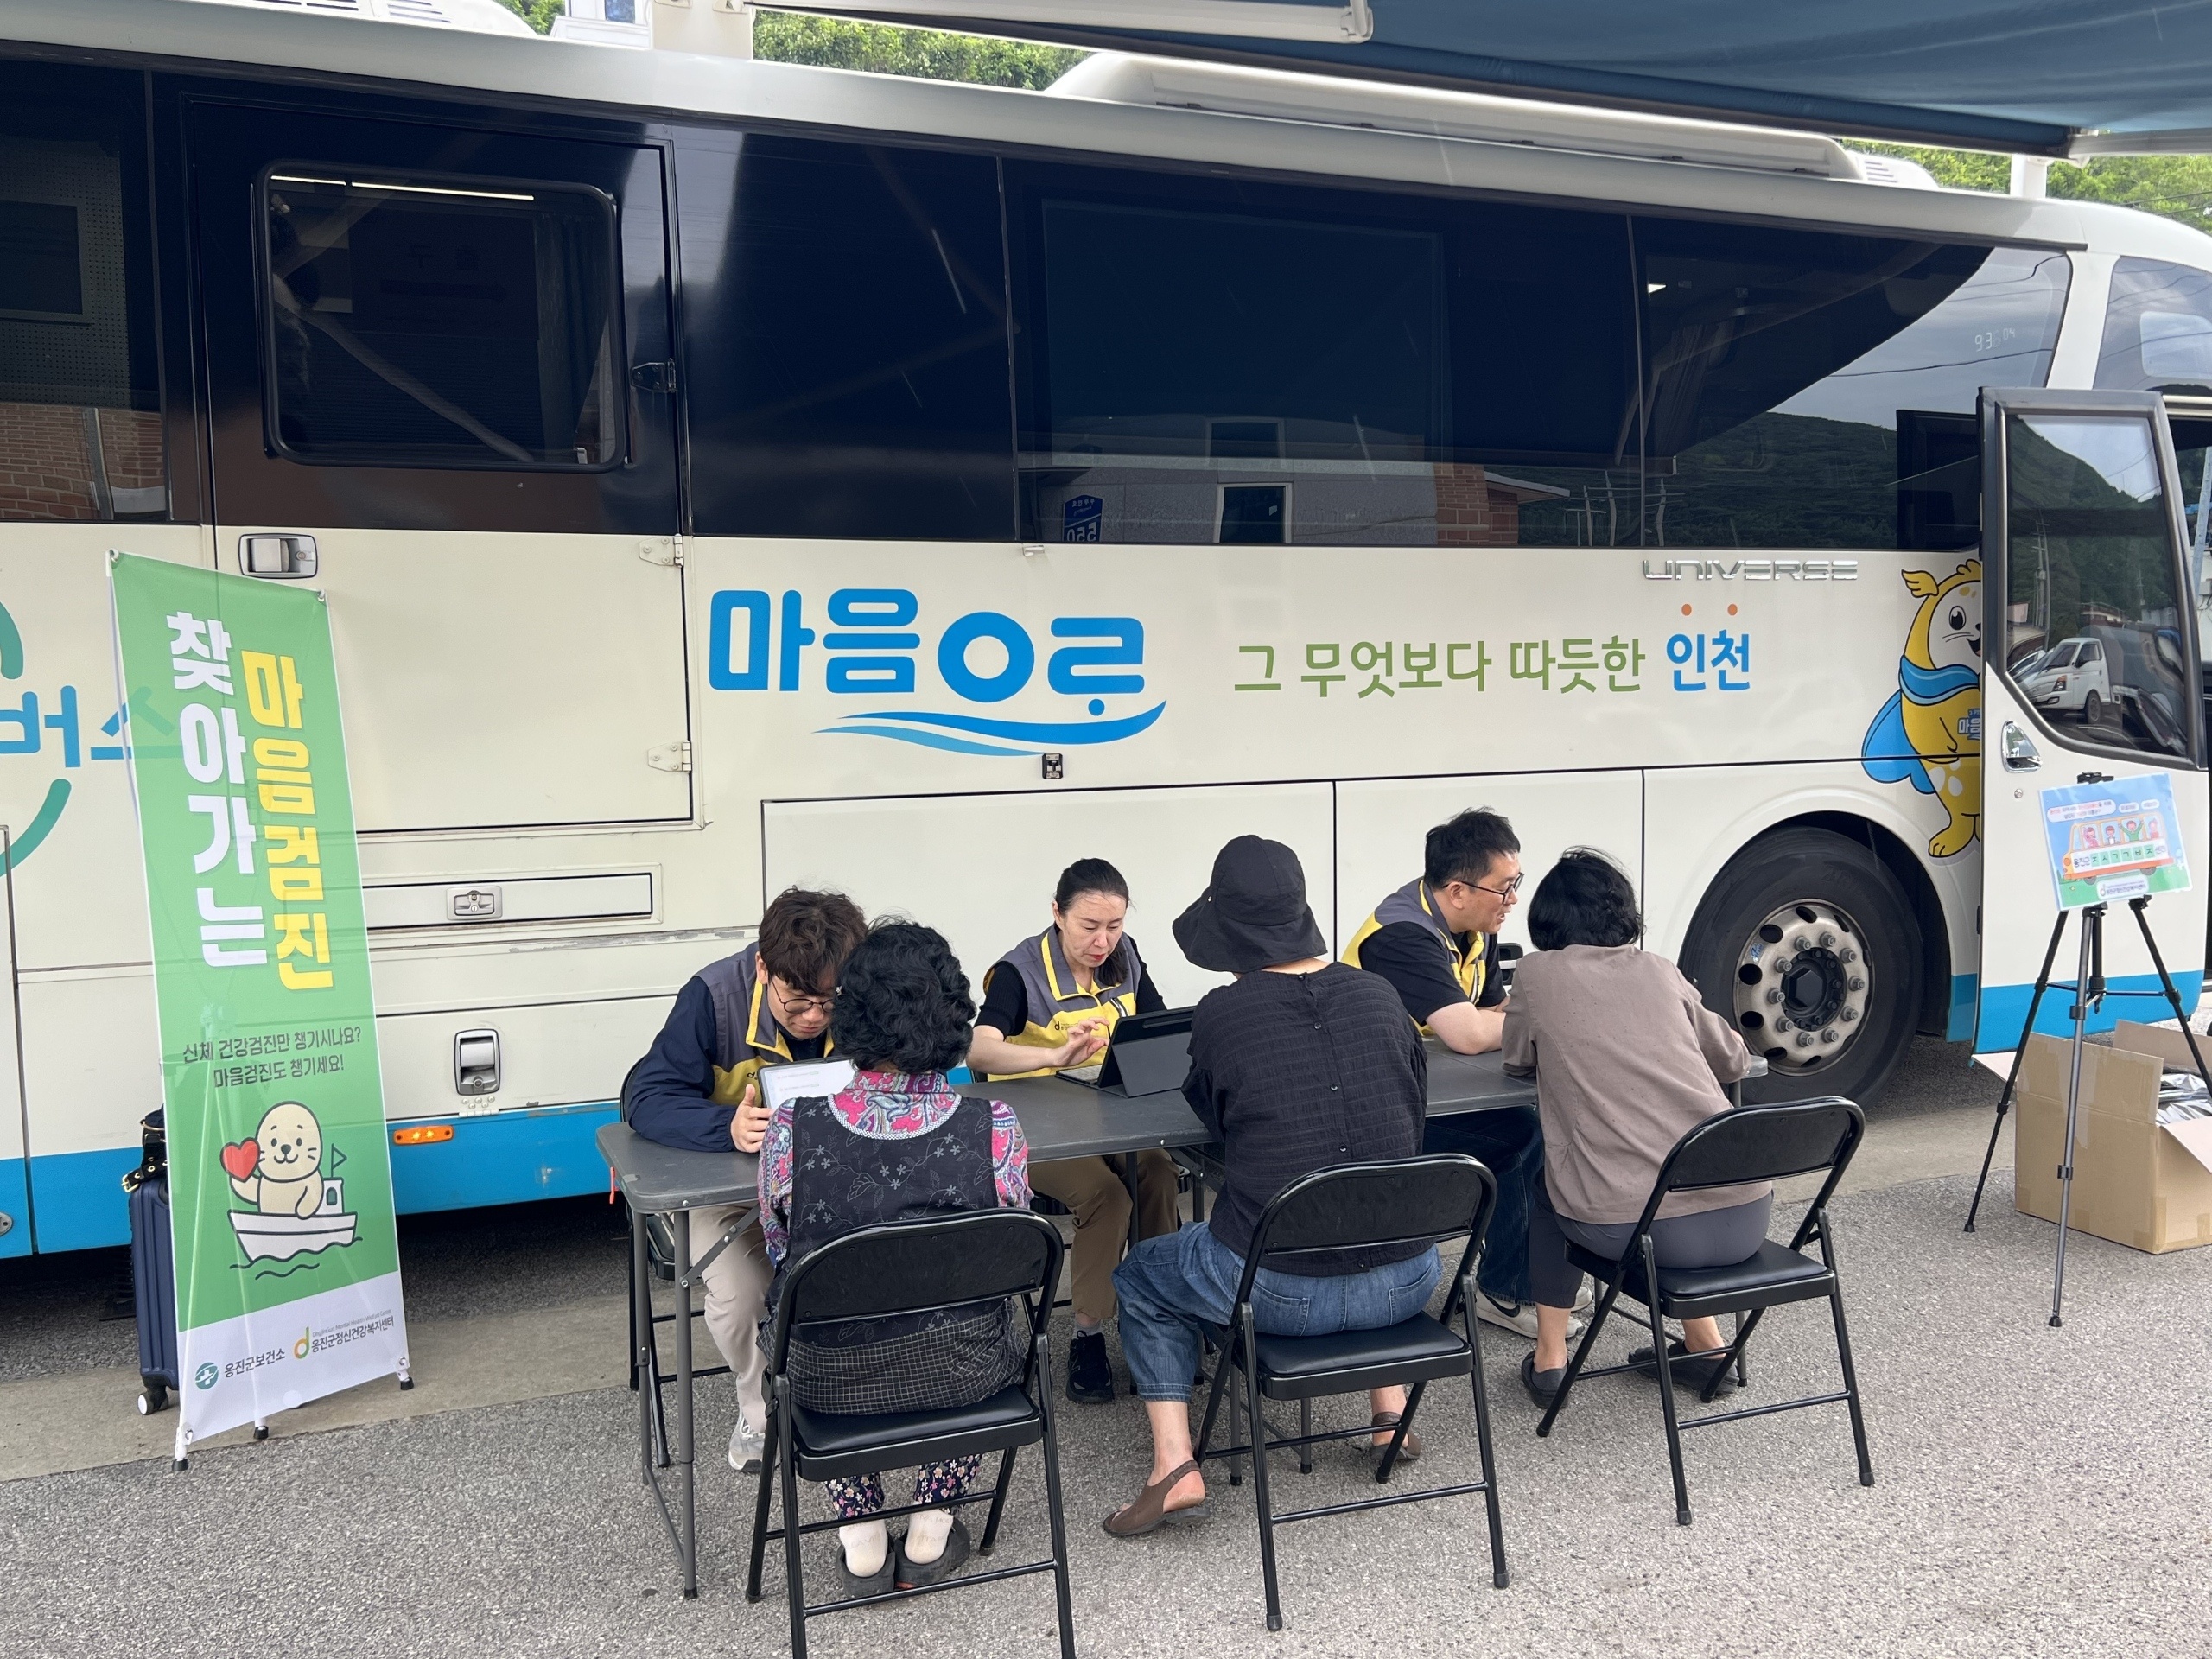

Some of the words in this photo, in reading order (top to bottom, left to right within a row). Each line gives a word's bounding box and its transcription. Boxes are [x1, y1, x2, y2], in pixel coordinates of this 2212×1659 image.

[1643, 559, 1858, 581] UNIVERSE
[1234, 645, 1281, 691] 그
[1300, 640, 1492, 699] 무엇보다
[1510, 635, 1646, 694] 따듯한
[1666, 628, 1751, 692] 인천
[1958, 718, 1980, 734] 마음
[166, 610, 269, 968] 찾아가는
[240, 649, 334, 991] 마음검진
[182, 1040, 214, 1064] 신체
[219, 1033, 290, 1059] 건강검진만
[294, 1026, 362, 1051] 챙기시나요?
[213, 1060, 287, 1089] 마음검진도
[290, 1053, 345, 1078] 챙기세요!
[311, 1314, 394, 1353] 옹진군정신건강복지센터
[224, 1348, 286, 1378] 옹진군보건소
